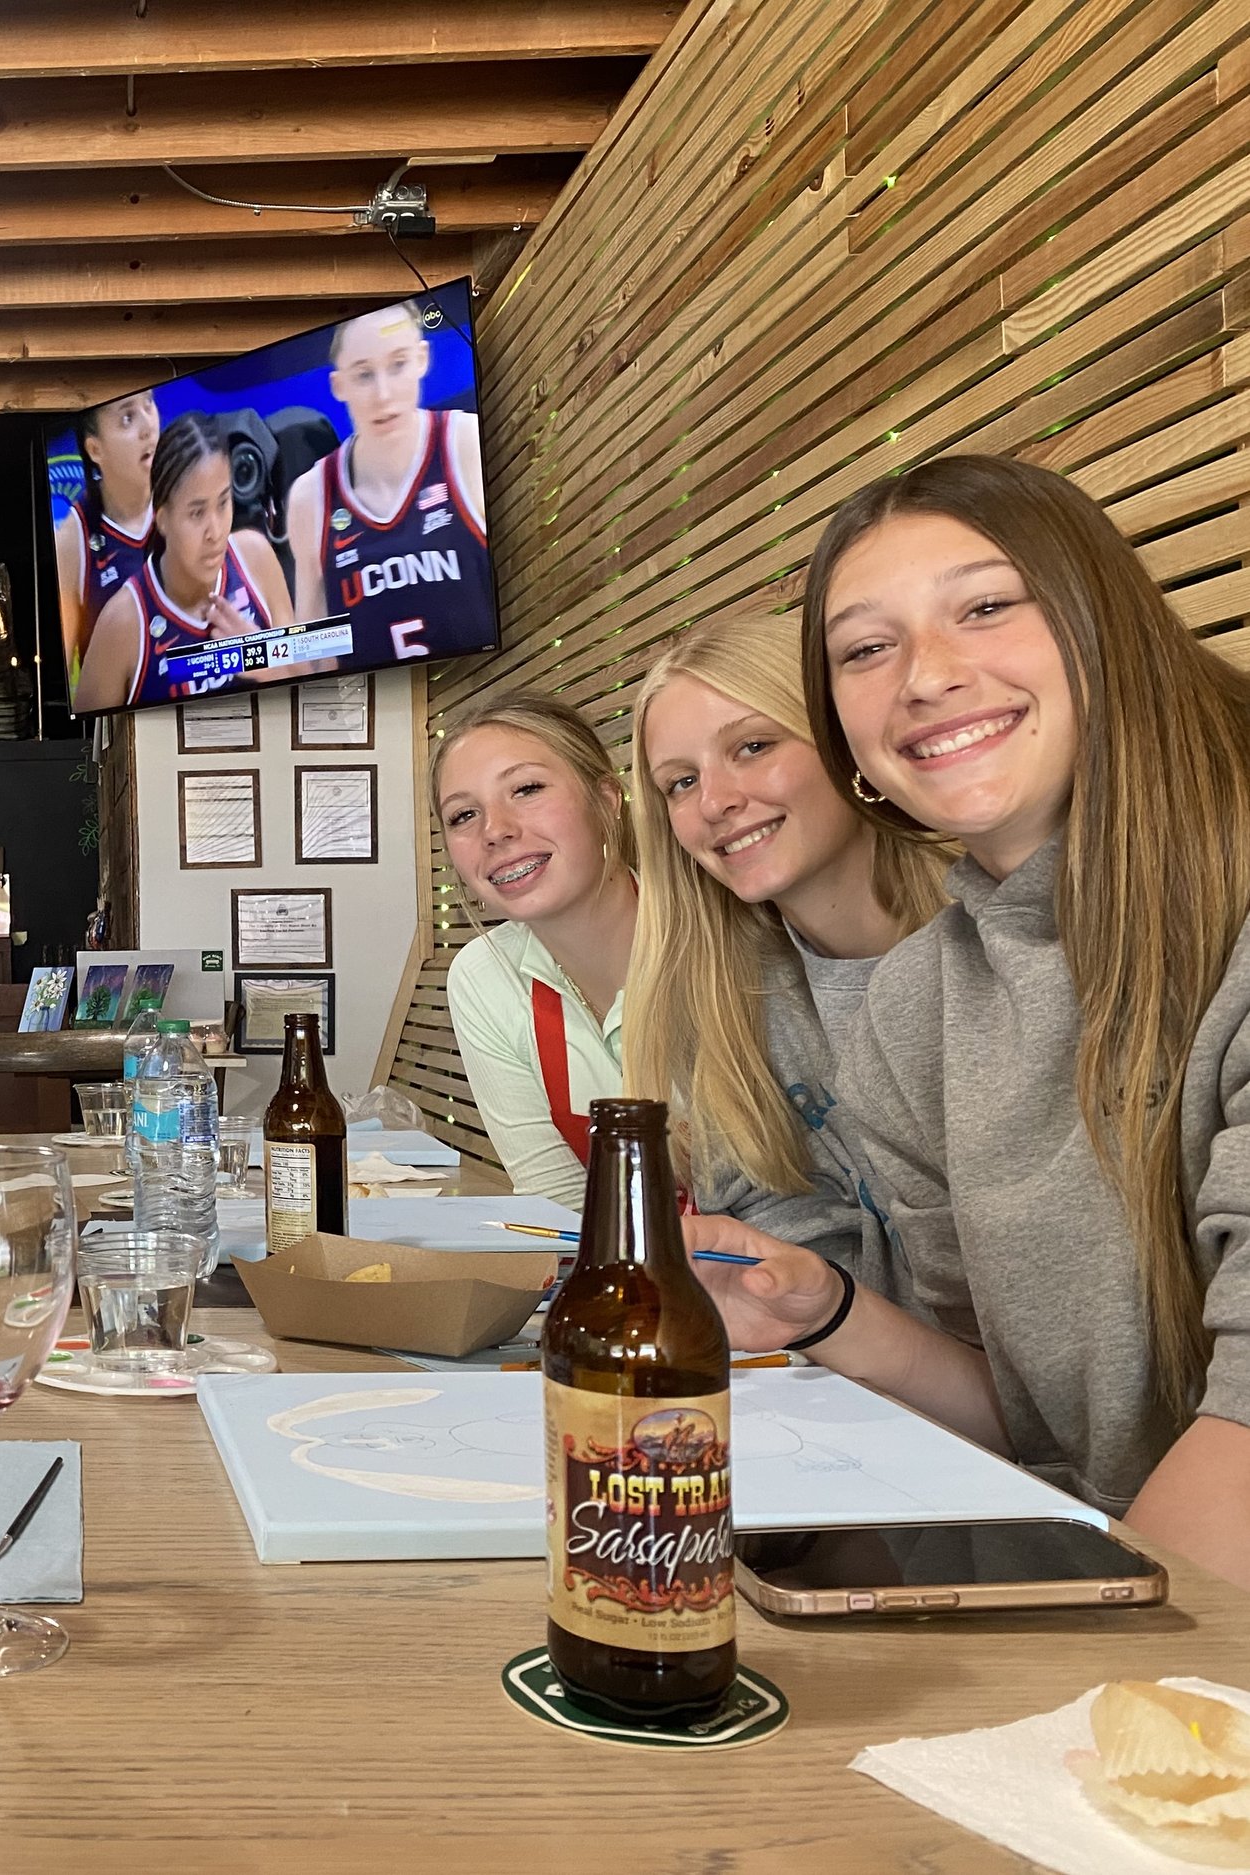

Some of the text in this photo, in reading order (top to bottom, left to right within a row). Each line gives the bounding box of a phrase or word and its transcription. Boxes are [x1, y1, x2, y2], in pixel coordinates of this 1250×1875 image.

[340, 550, 462, 609] UCONN
[301, 635, 319, 645] SOUTH
[320, 628, 349, 640] CAROLINA
[190, 653, 215, 665] UCONN
[246, 646, 263, 657] 39.9
[271, 643, 289, 659] 42
[221, 652, 240, 669] 59
[245, 656, 265, 667] 30 3Q
[589, 1467, 731, 1517] LOST TRAI
[595, 1609, 630, 1626] Sugar
[641, 1617, 668, 1628] Low
[670, 1615, 712, 1629] Sodium
